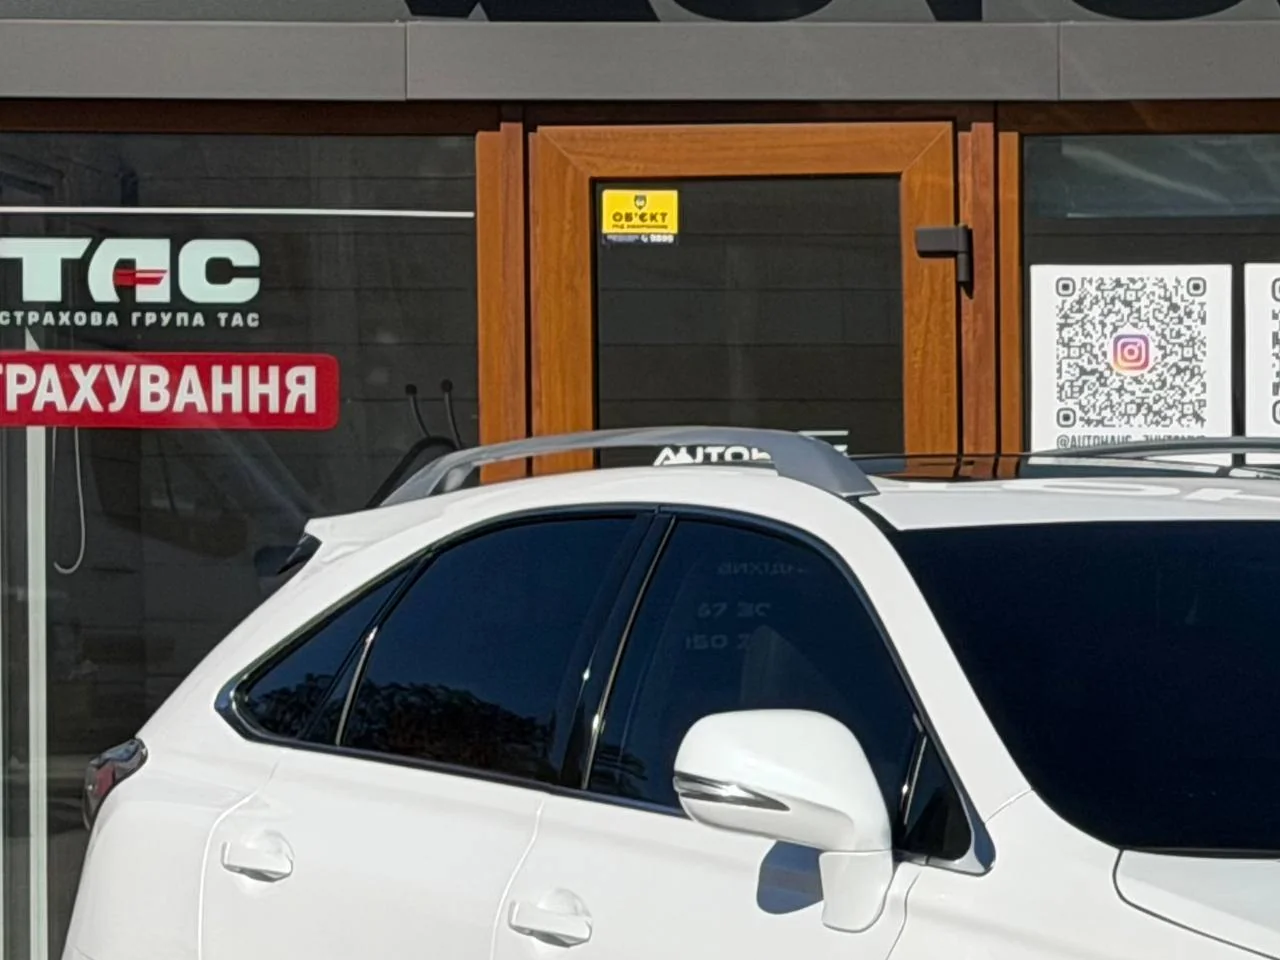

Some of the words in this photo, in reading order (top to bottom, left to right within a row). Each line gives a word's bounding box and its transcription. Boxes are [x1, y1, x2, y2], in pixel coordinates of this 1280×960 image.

[0, 311, 118, 327] СТРАХОВА
[131, 312, 205, 328] ГРУПА
[217, 313, 260, 328] ТАС
[0, 363, 317, 414] РАХУВАННЯ
